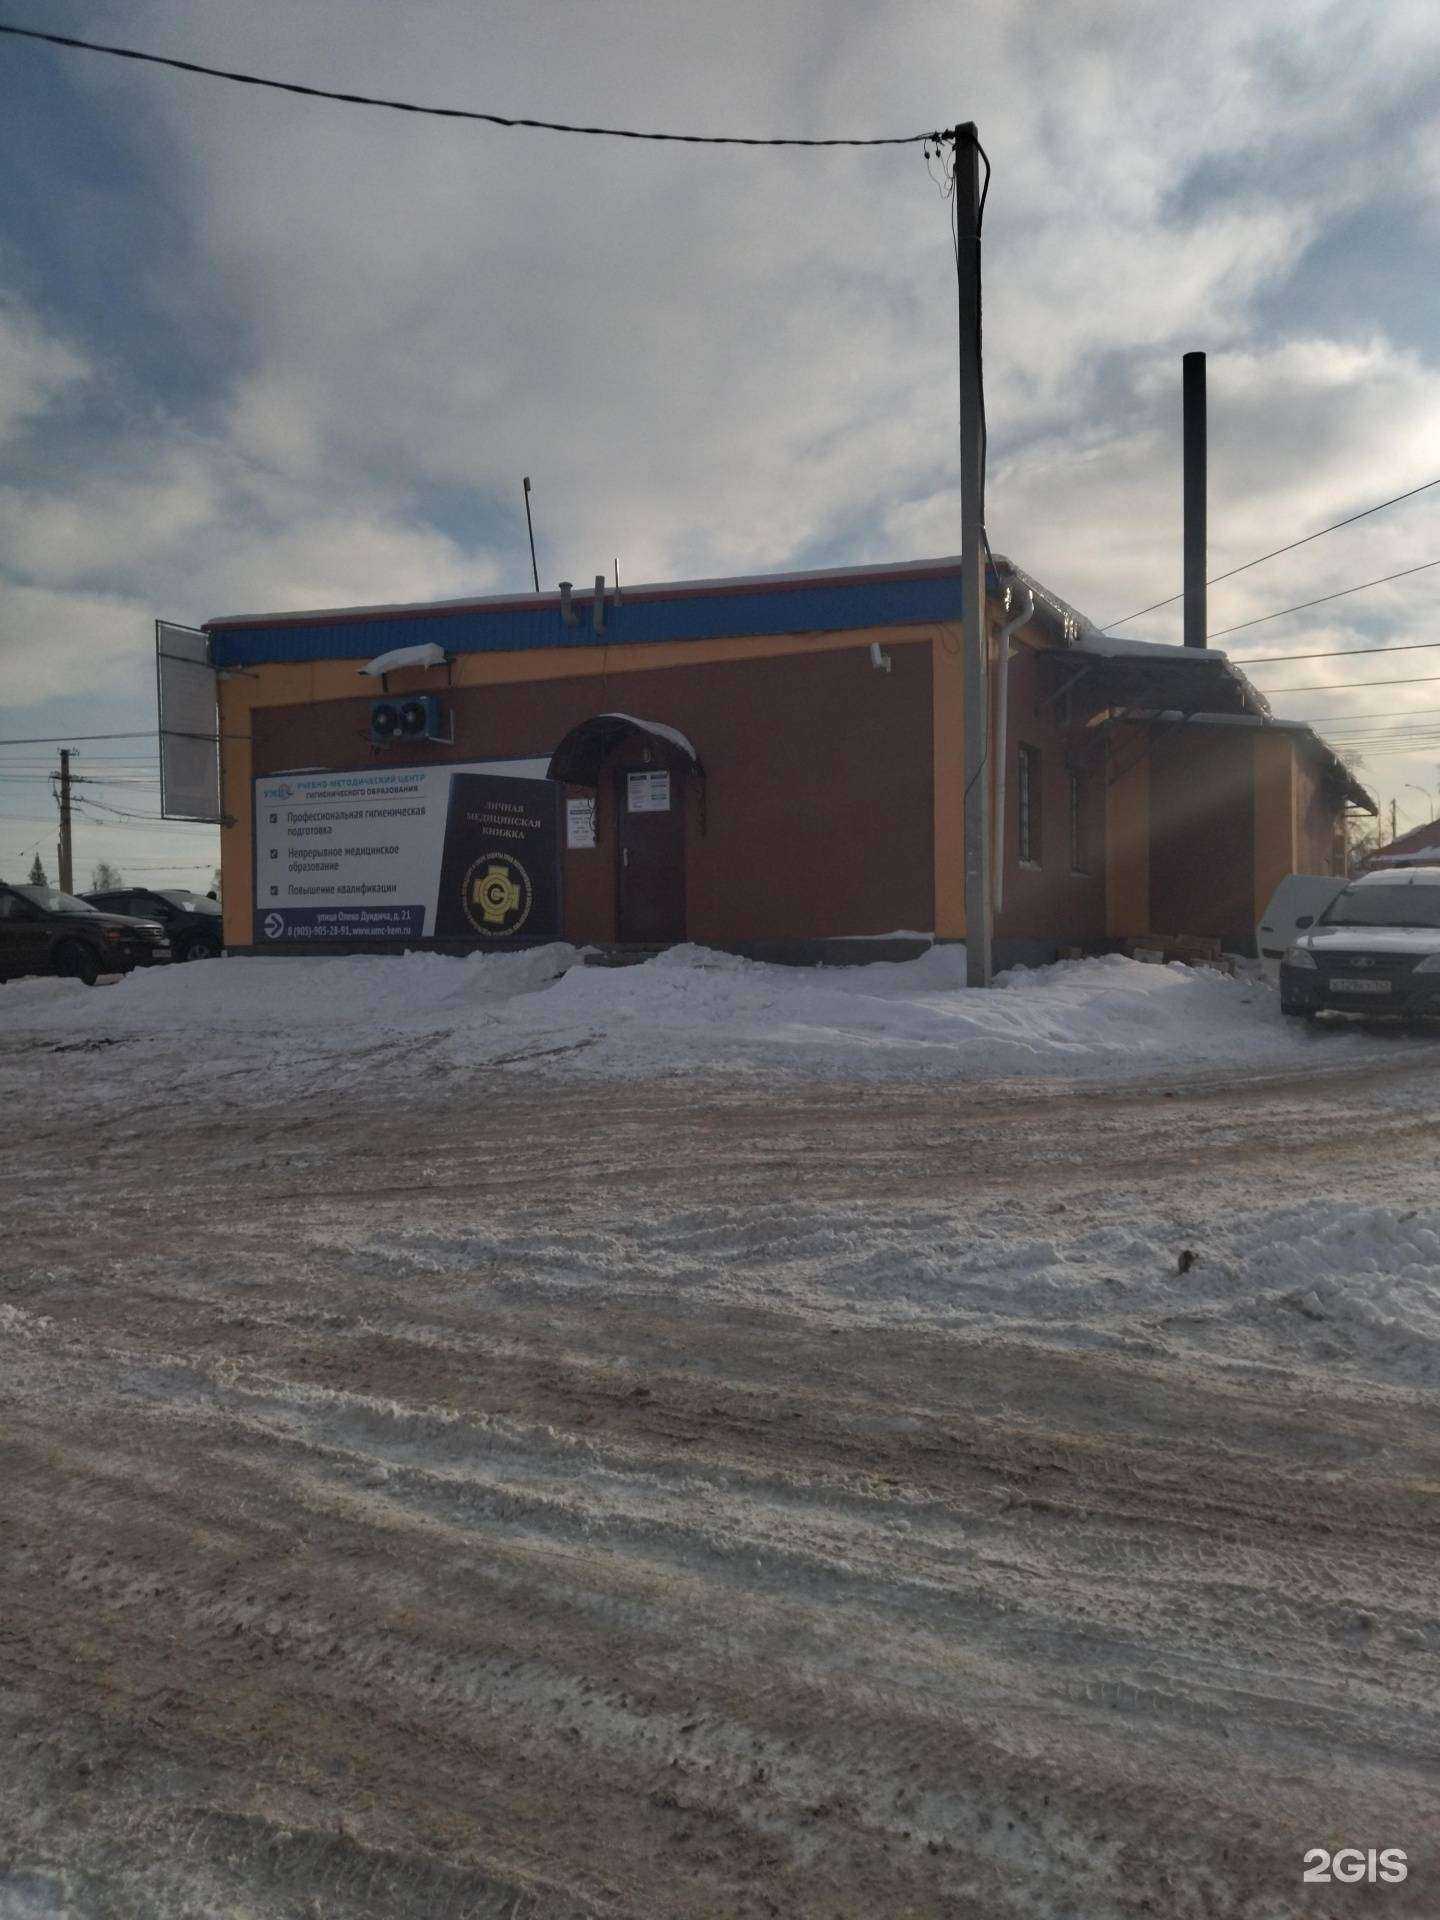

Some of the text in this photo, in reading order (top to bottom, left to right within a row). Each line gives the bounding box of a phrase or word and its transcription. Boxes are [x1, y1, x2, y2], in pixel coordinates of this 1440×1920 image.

[398, 774, 425, 784] ЦЕНТР
[305, 786, 418, 799] ГИГИЕНИЧЕСКОГО ОБРАЗОВАНИЯ
[287, 807, 425, 824] Профессиональная гигиеническая
[287, 826, 333, 838] подготовка
[482, 827, 525, 839] КНИЖКА
[288, 846, 400, 860] Непрерывное медицинское
[288, 862, 340, 873] образование
[288, 883, 397, 895] Повышение квалификации
[318, 913, 337, 922] улица
